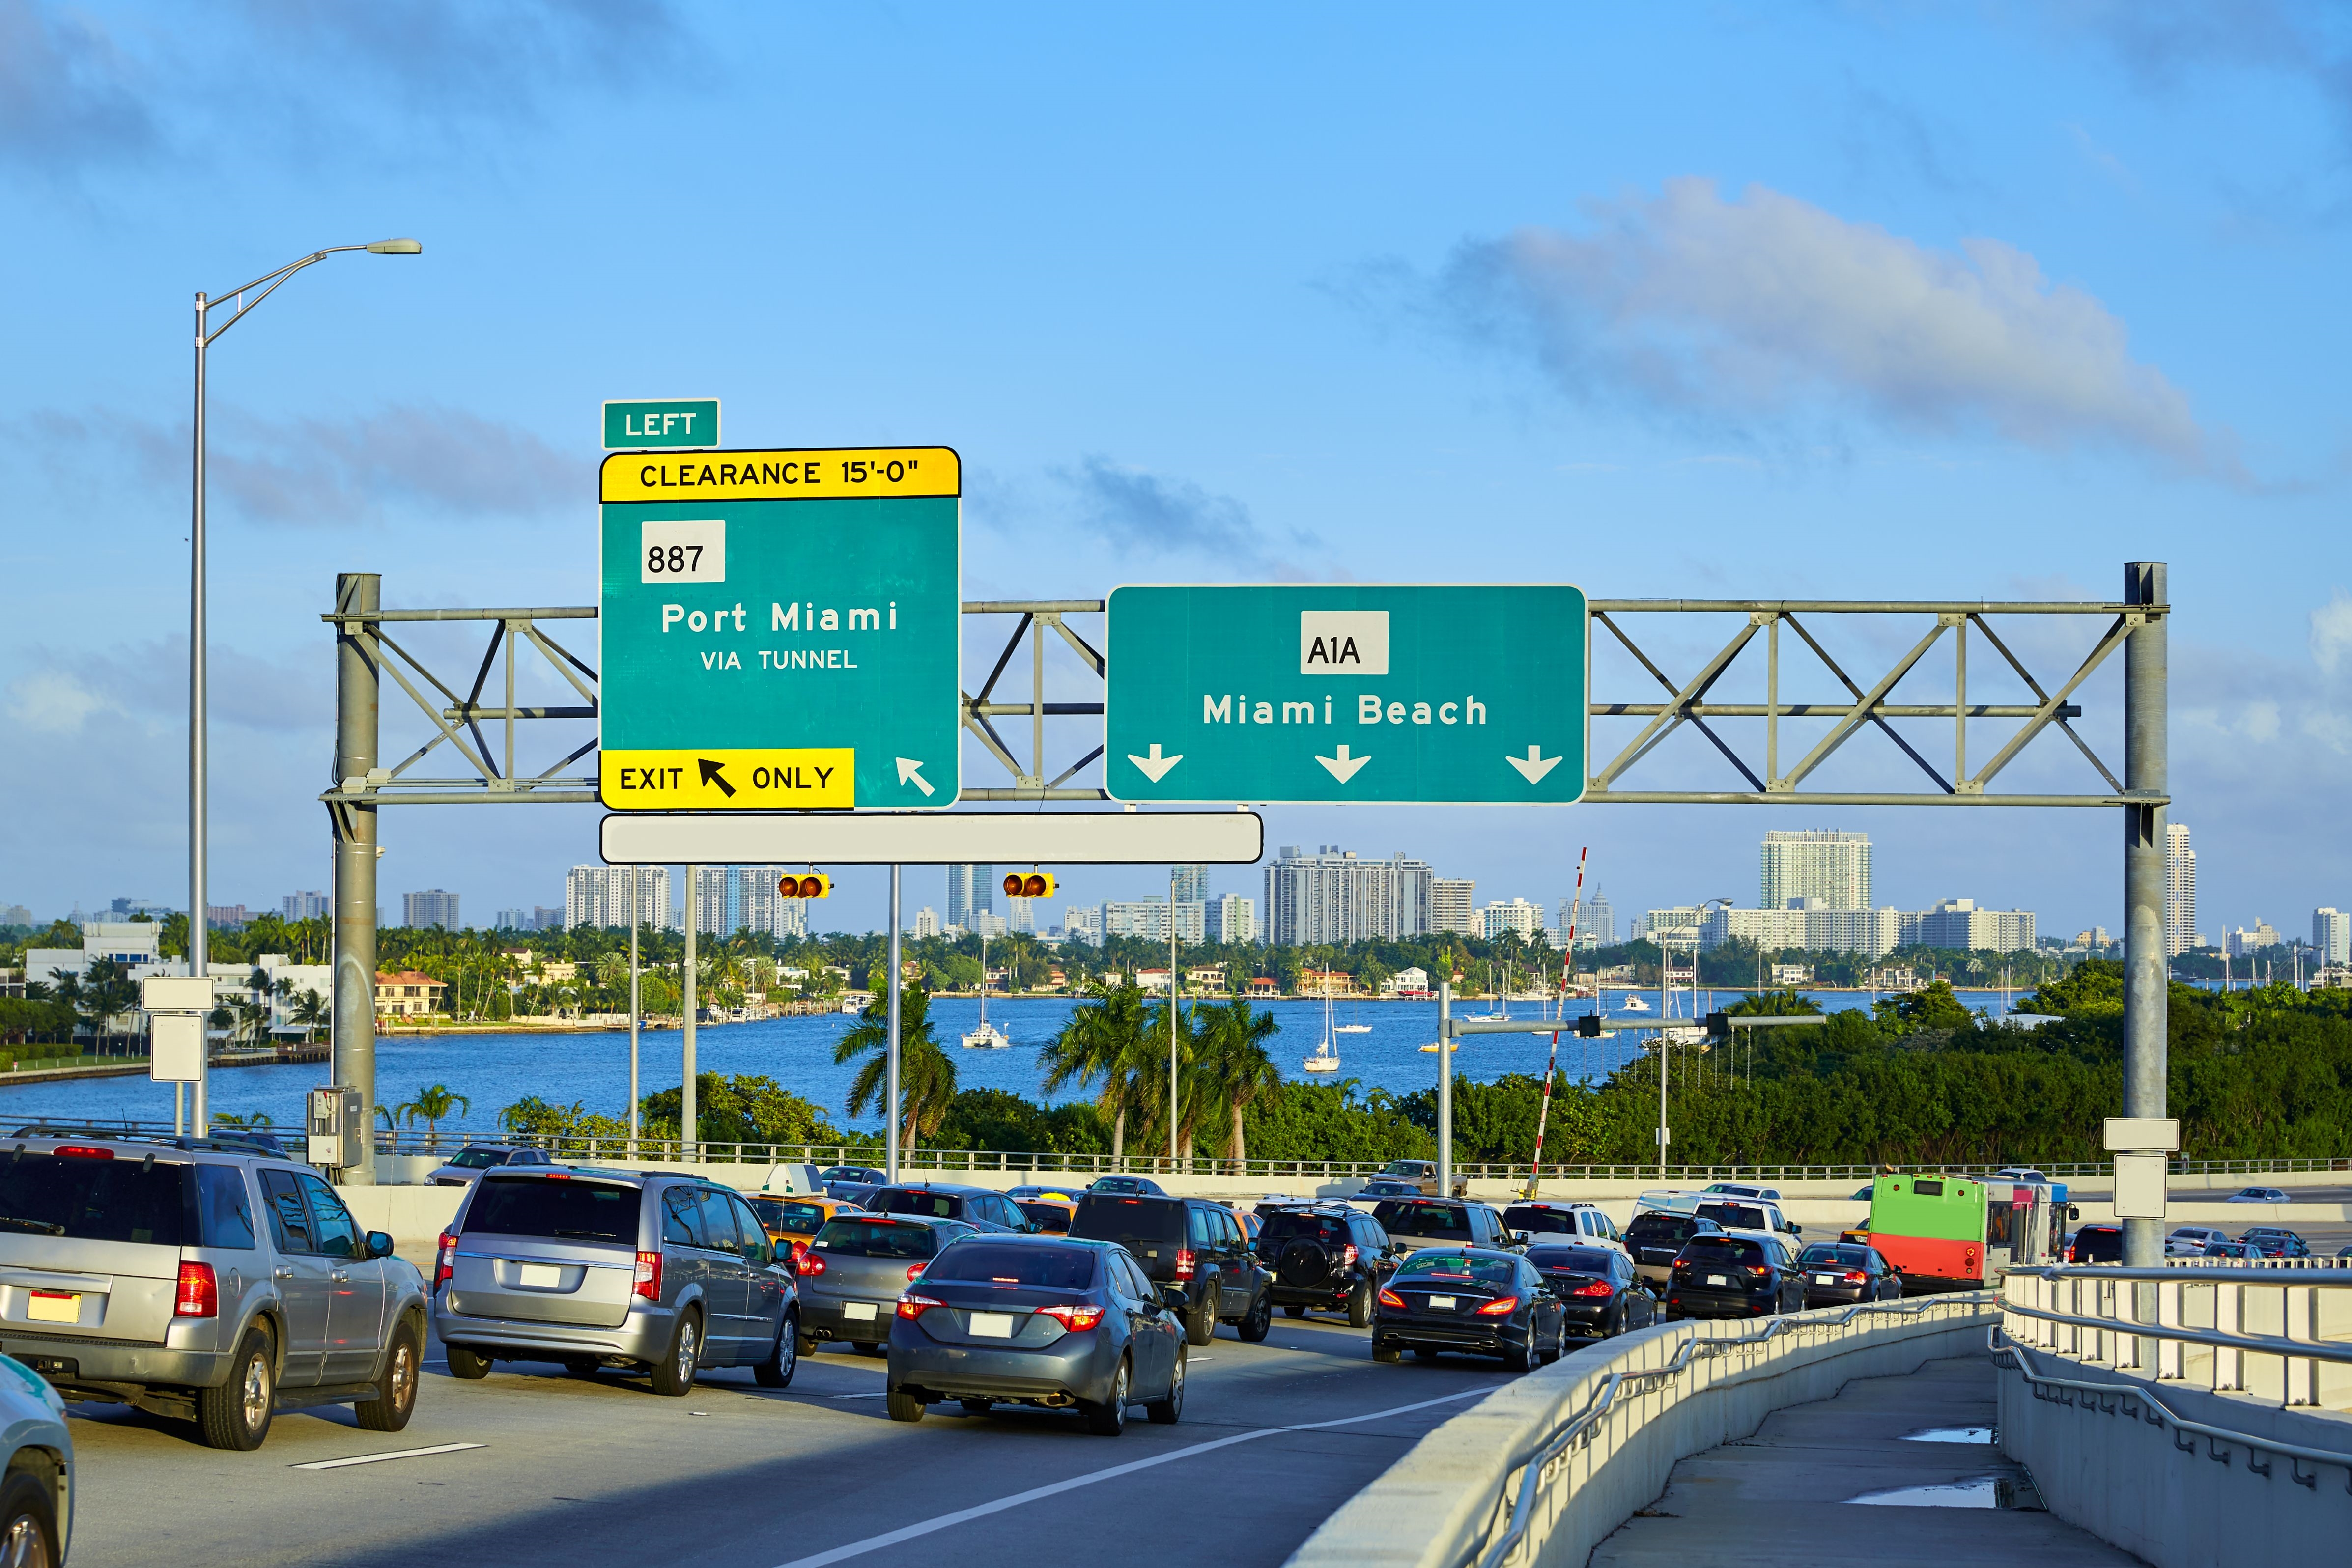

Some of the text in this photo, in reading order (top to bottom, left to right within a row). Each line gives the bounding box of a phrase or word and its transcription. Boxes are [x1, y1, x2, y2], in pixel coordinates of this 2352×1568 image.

[626, 413, 697, 436] LEFT
[640, 460, 918, 487] CLEARANCE 15'-0"
[648, 545, 703, 573] 887
[662, 601, 896, 633] Port Miami
[701, 650, 857, 670] VIA TUNNEL
[1307, 636, 1361, 664] A1A
[1204, 695, 1486, 725] Miami Beach
[621, 767, 834, 789] EXIT ONLY
